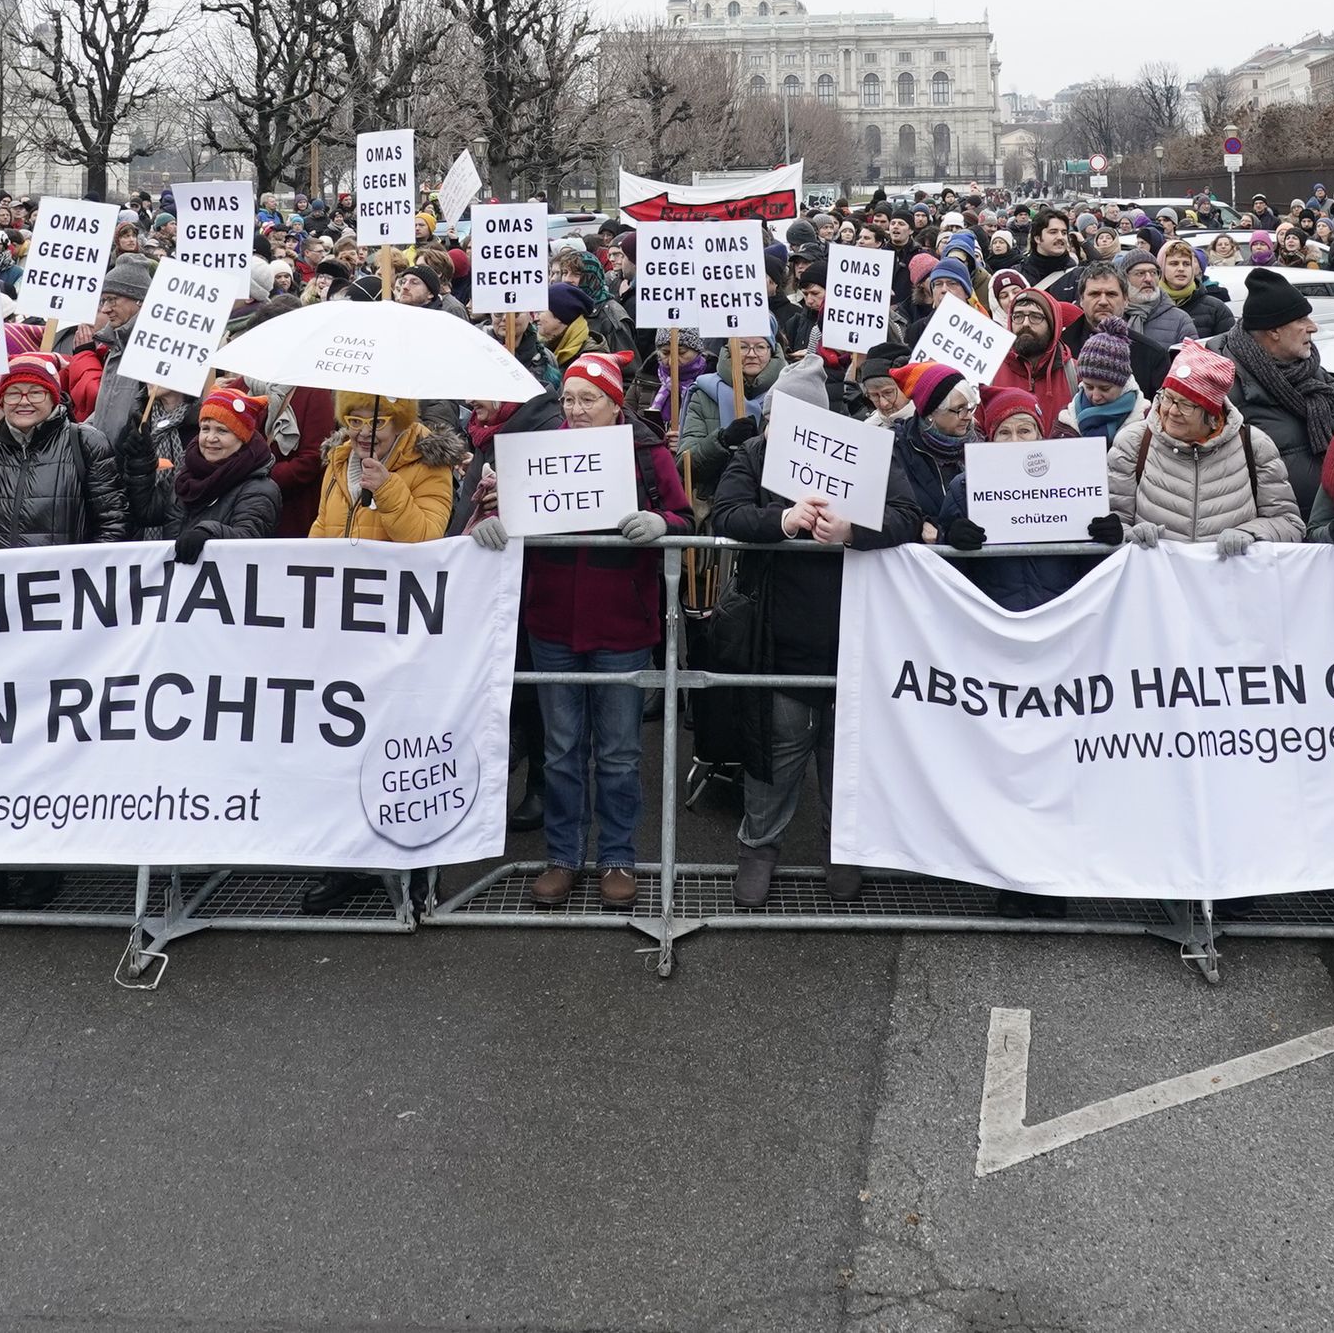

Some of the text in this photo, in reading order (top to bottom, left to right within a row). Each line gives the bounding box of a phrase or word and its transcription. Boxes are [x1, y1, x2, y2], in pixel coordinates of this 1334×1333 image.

[366, 146, 402, 162] OMAS
[363, 173, 407, 189] GEGEN
[190, 196, 239, 211] OMAS
[360, 200, 411, 216] RECHTS
[724, 201, 788, 218] Vektor
[50, 214, 100, 234] OMAS
[186, 224, 244, 240] GEGEN
[486, 218, 533, 233] OMAS
[38, 241, 100, 263] GEGEN
[481, 244, 538, 259] GEGEN
[705, 237, 748, 253] OMAS
[646, 262, 695, 275] GEGE
[702, 264, 756, 280] GEGEN
[840, 259, 880, 277] OMAS
[27, 269, 98, 293] RECHTS
[476, 270, 543, 285] RECHTS
[167, 277, 220, 303] OMAS
[641, 288, 696, 301] RECHT
[834, 284, 882, 303] GEGEN
[700, 292, 763, 308] RECHTS
[150, 303, 215, 333] GEGEN
[827, 308, 884, 329] RECHTS
[949, 314, 994, 350] OMAS
[134, 330, 209, 364] RECHTS
[333, 335, 376, 347] OMAS
[324, 347, 374, 360] GEGEN
[932, 332, 987, 374] GEGEN
[315, 360, 371, 375] RECHTS
[793, 424, 859, 466] HETZE
[527, 453, 602, 477] HETZE
[1027, 459, 1046, 467] GEGEN
[789, 456, 855, 500] TÖTET
[528, 489, 605, 513] TÖTET
[973, 486, 1103, 502] MENSCHENRECHTE
[1011, 513, 1068, 525] schützen
[891, 660, 1114, 719] ABSTAND
[1130, 664, 1307, 709] HALTEN
[47, 672, 366, 748] RECHTS
[384, 731, 453, 761] OMAS
[382, 759, 457, 795] GEGEN
[378, 788, 467, 827] RECHTS
